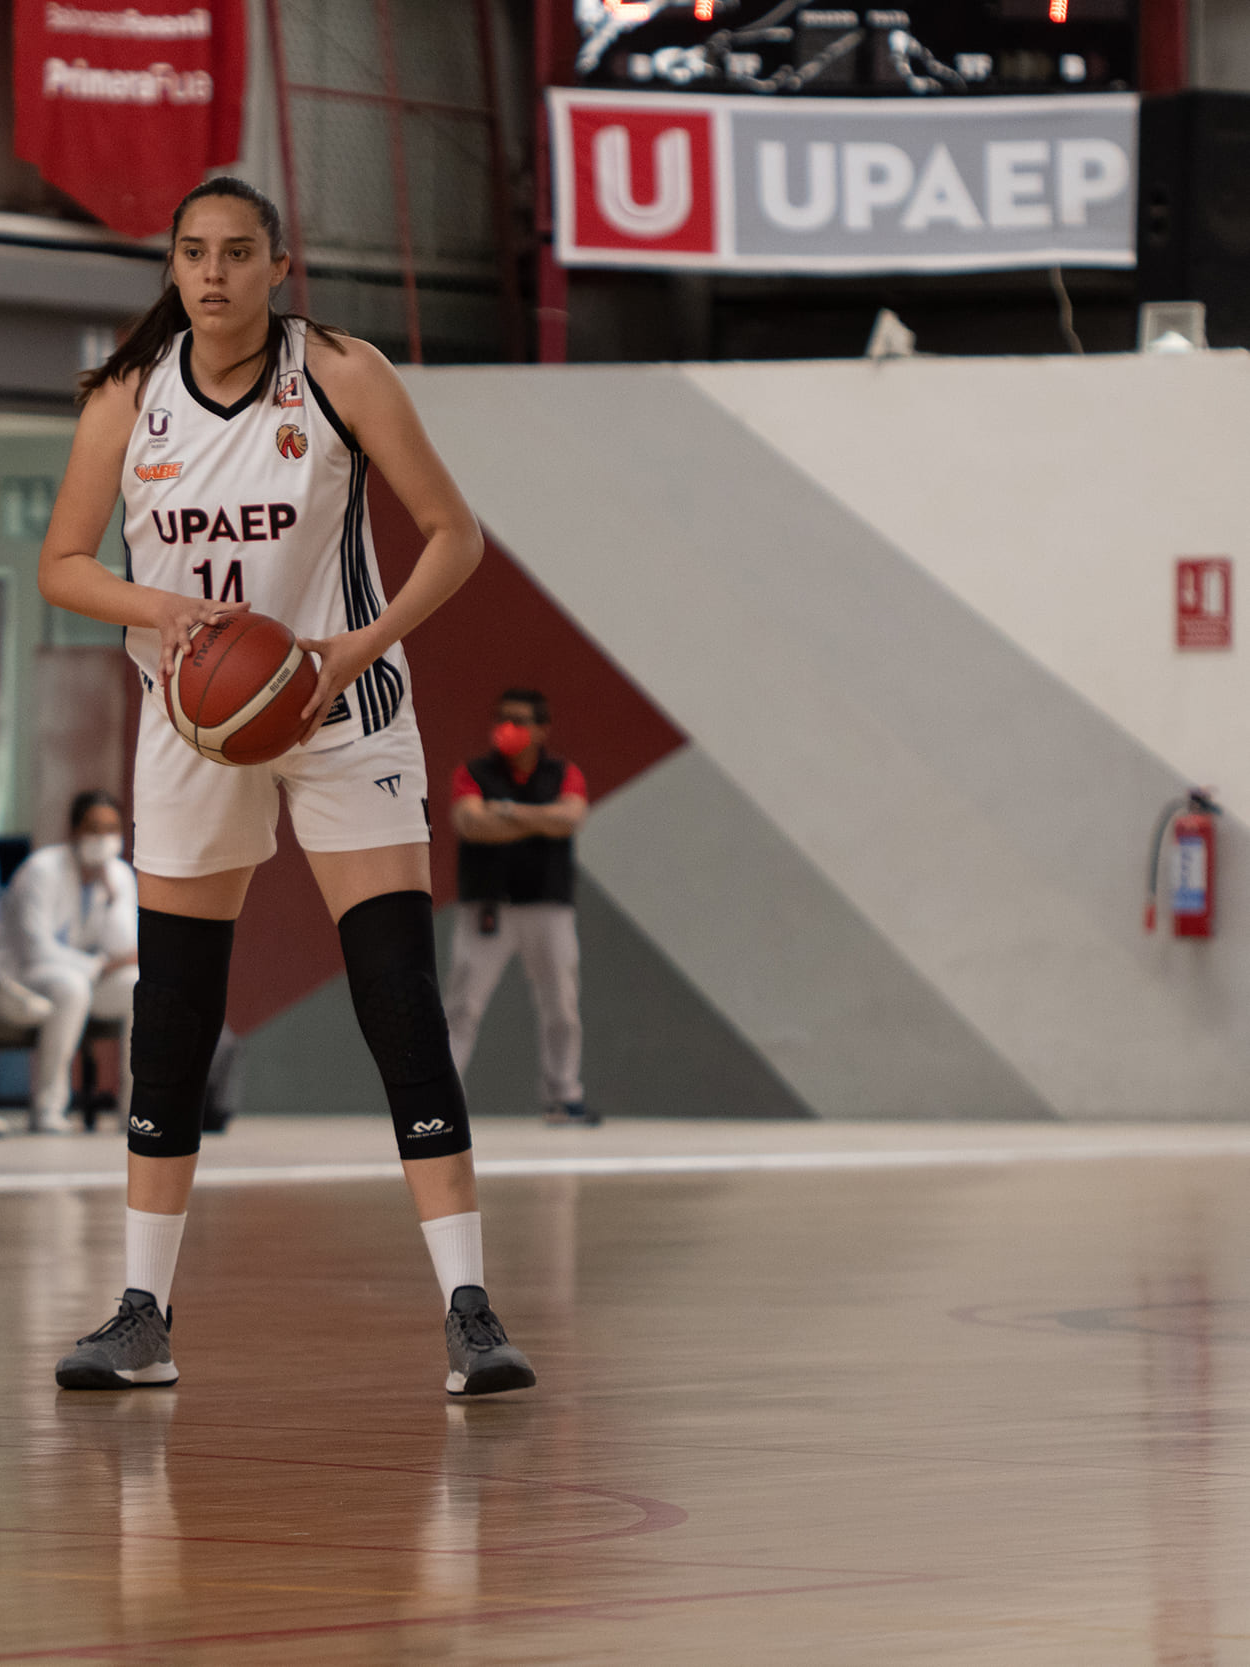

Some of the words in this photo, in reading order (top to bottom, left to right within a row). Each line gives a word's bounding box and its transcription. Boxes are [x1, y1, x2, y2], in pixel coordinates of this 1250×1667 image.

[593, 125, 694, 239] U
[757, 138, 1130, 232] UPAEP
[151, 503, 298, 545] UPAEP
[193, 559, 244, 603] 14
